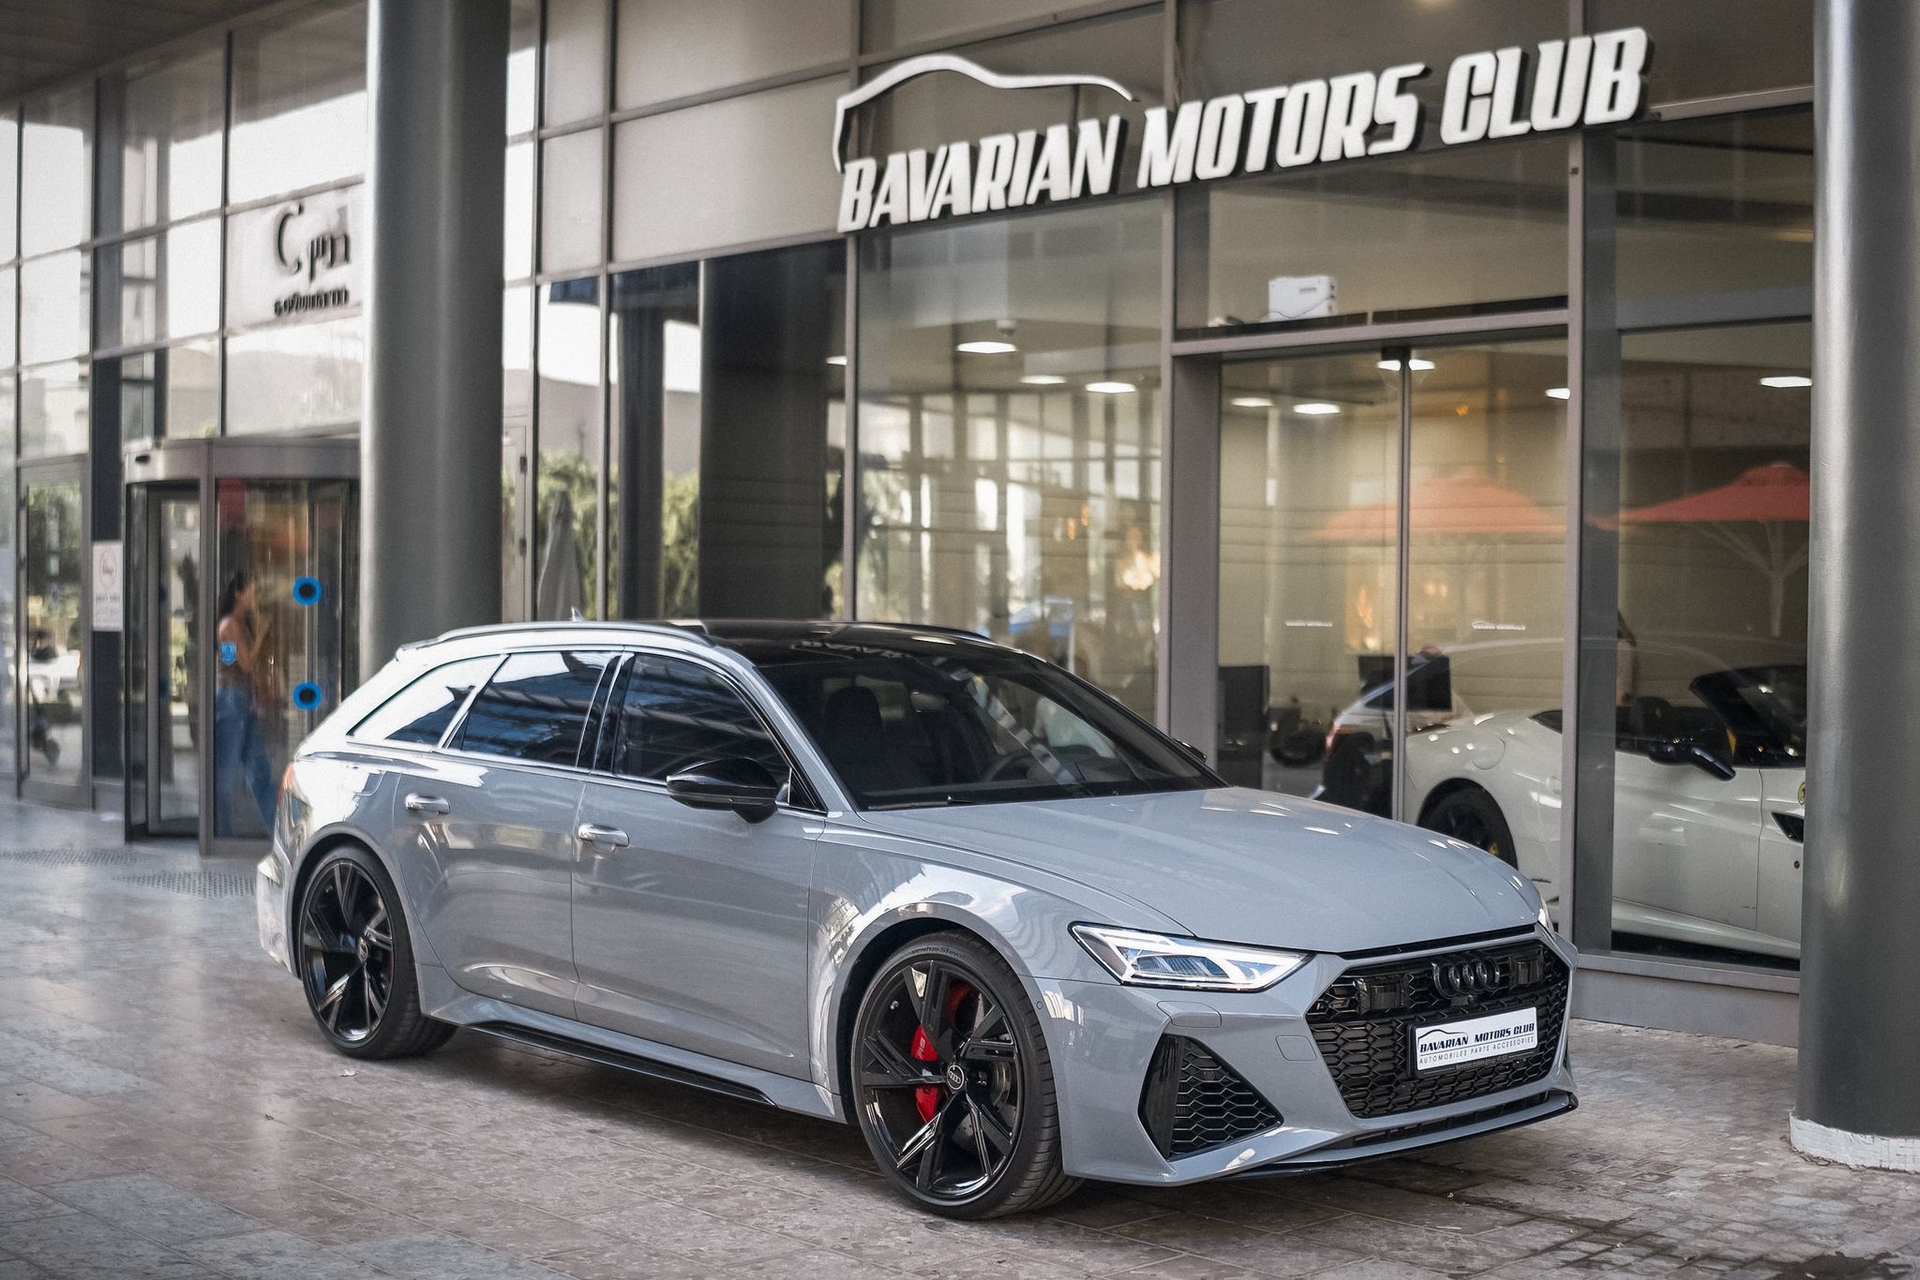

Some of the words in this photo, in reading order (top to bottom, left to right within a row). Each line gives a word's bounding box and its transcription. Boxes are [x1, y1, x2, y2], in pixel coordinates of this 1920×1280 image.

[836, 114, 1124, 234] BAVARIAN
[1137, 62, 1428, 189] MOTORS
[1440, 27, 1651, 146] CLUB
[273, 201, 304, 276] C
[1419, 1036, 1469, 1053] BAVARIAN
[1474, 1027, 1511, 1043] MOTORS
[1513, 1022, 1535, 1035] CLUB
[1419, 1049, 1468, 1065] AUTOMOBILES
[1470, 1046, 1490, 1055] PARTS
[1493, 1036, 1535, 1050] ACCESSORIES
